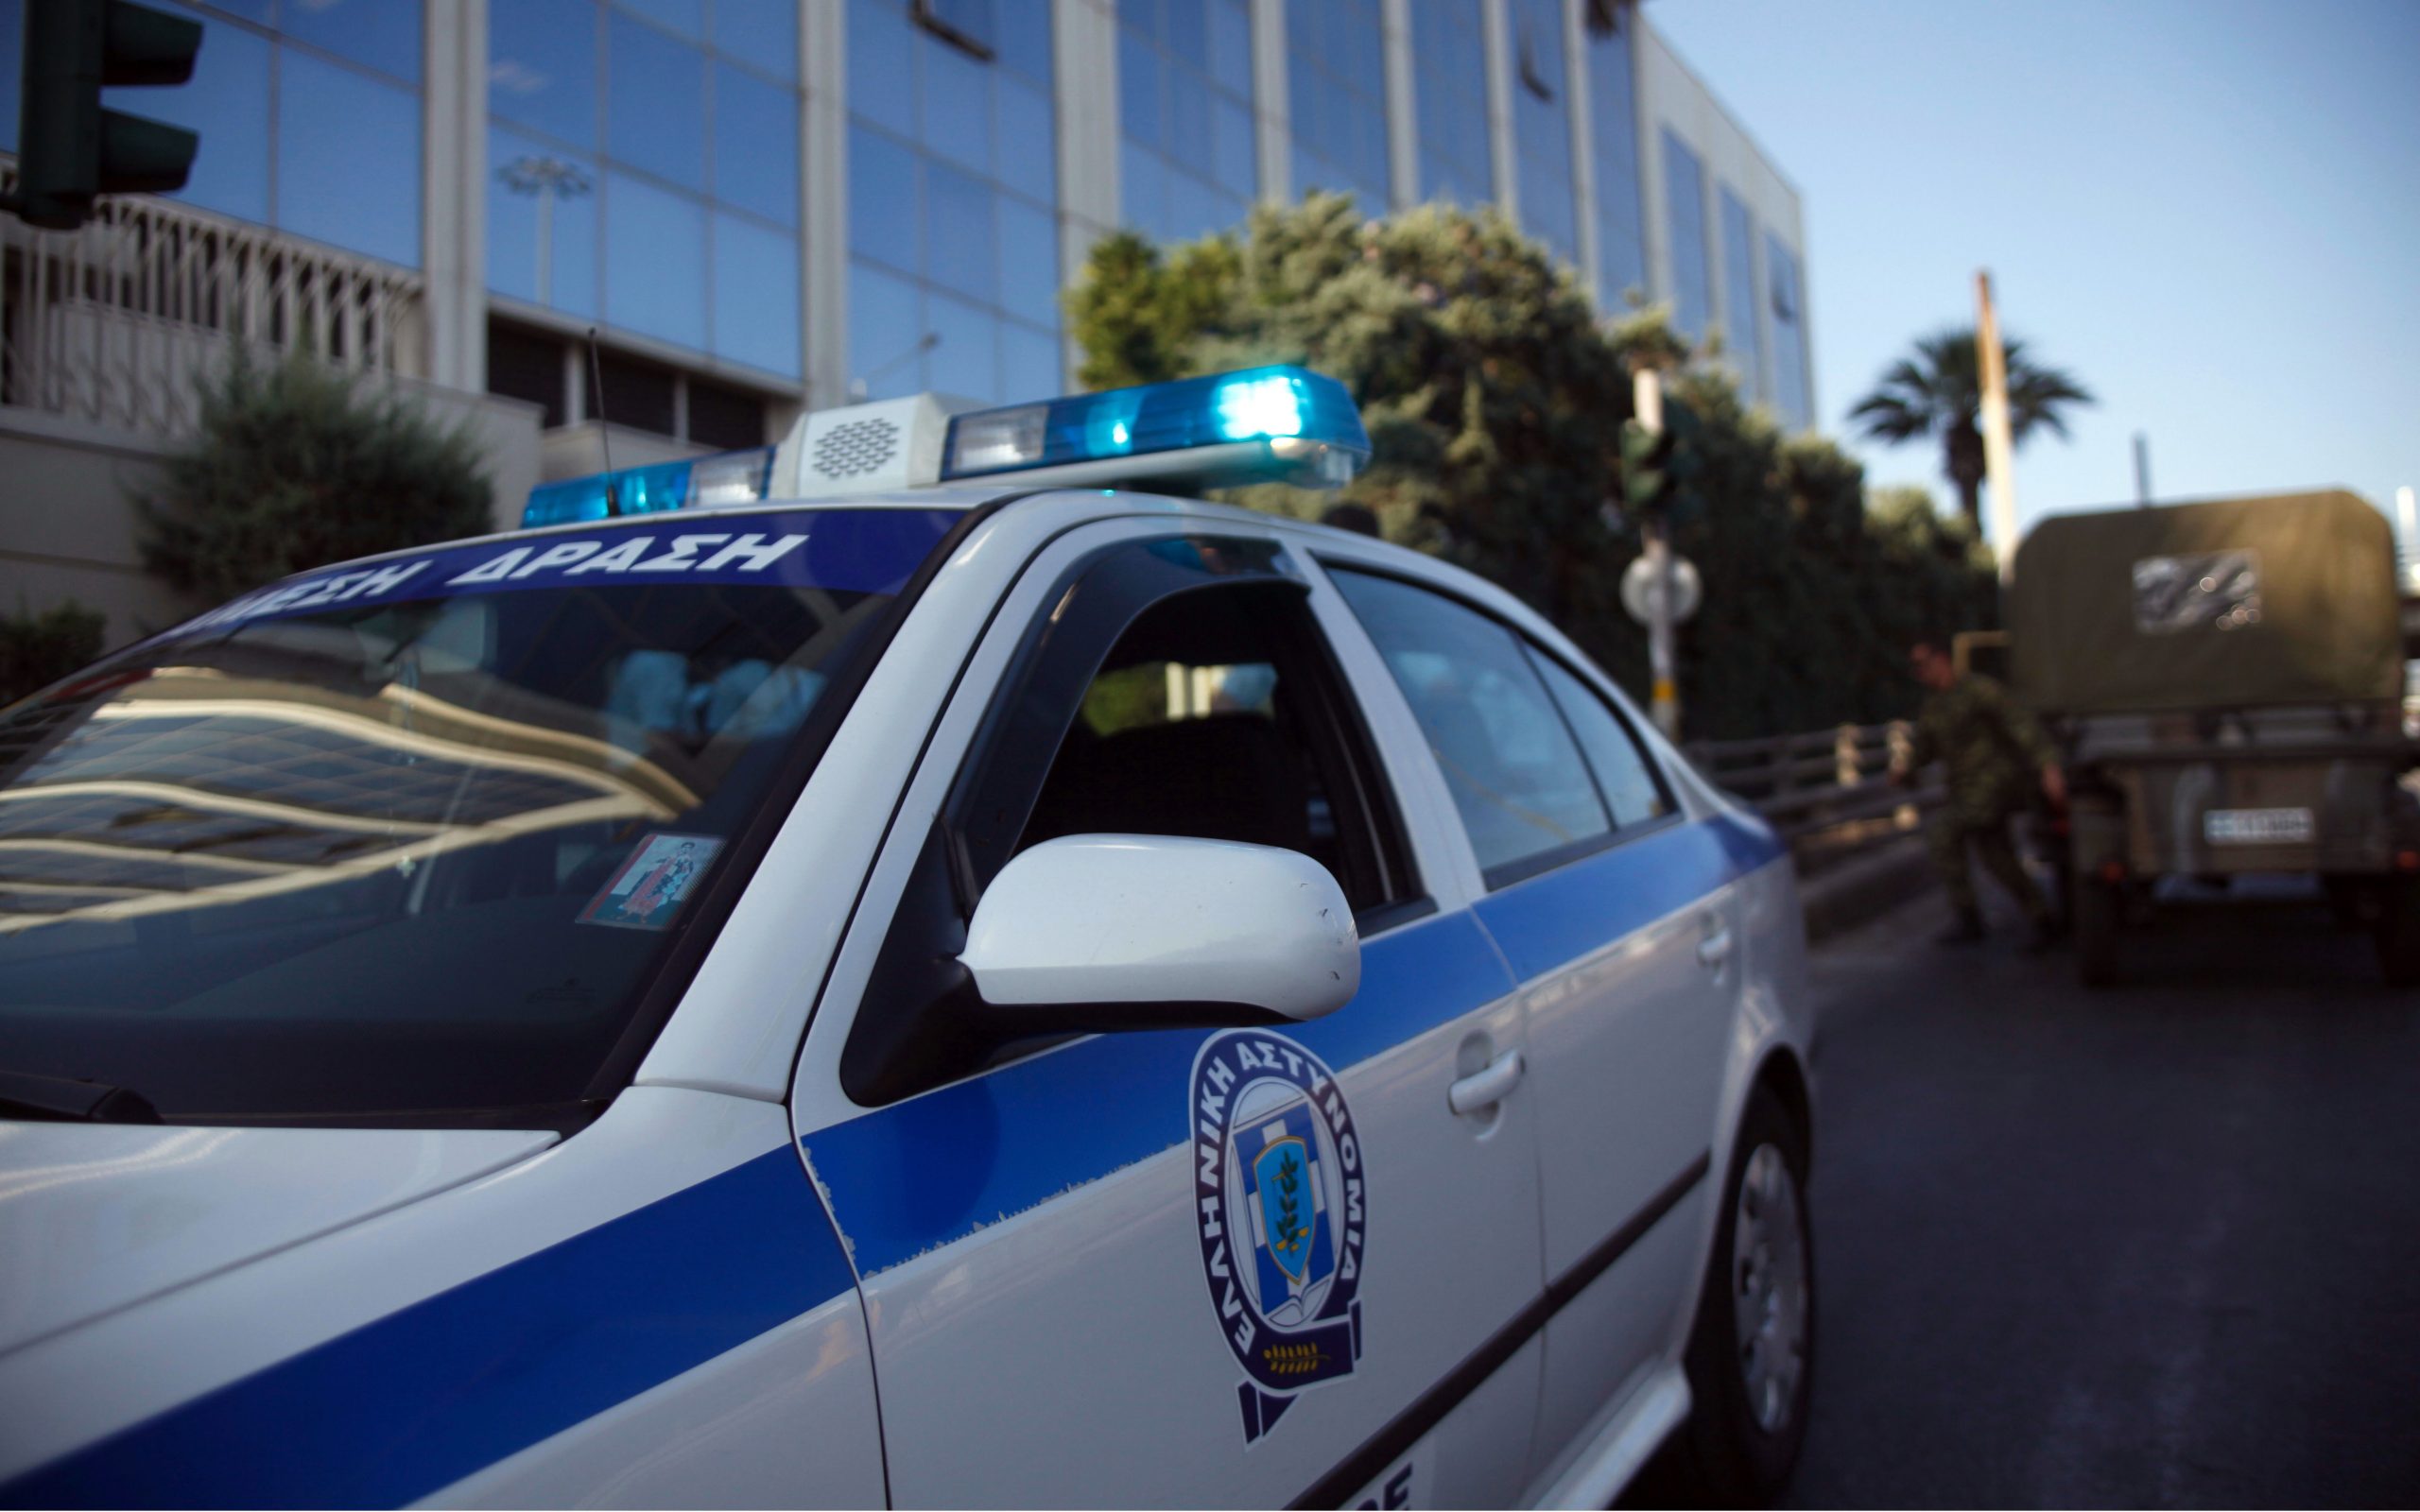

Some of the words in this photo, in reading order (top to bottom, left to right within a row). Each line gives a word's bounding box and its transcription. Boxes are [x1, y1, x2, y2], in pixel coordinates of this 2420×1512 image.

[163, 559, 433, 638] ΕΣΗ
[444, 533, 811, 586] ΔΡΑΣΗ
[1200, 1056, 1256, 1356] ΕΛΛΗΝΙΚΗ
[1236, 1040, 1362, 1280] ΑΣΤΥΝΟΜΙΑ
